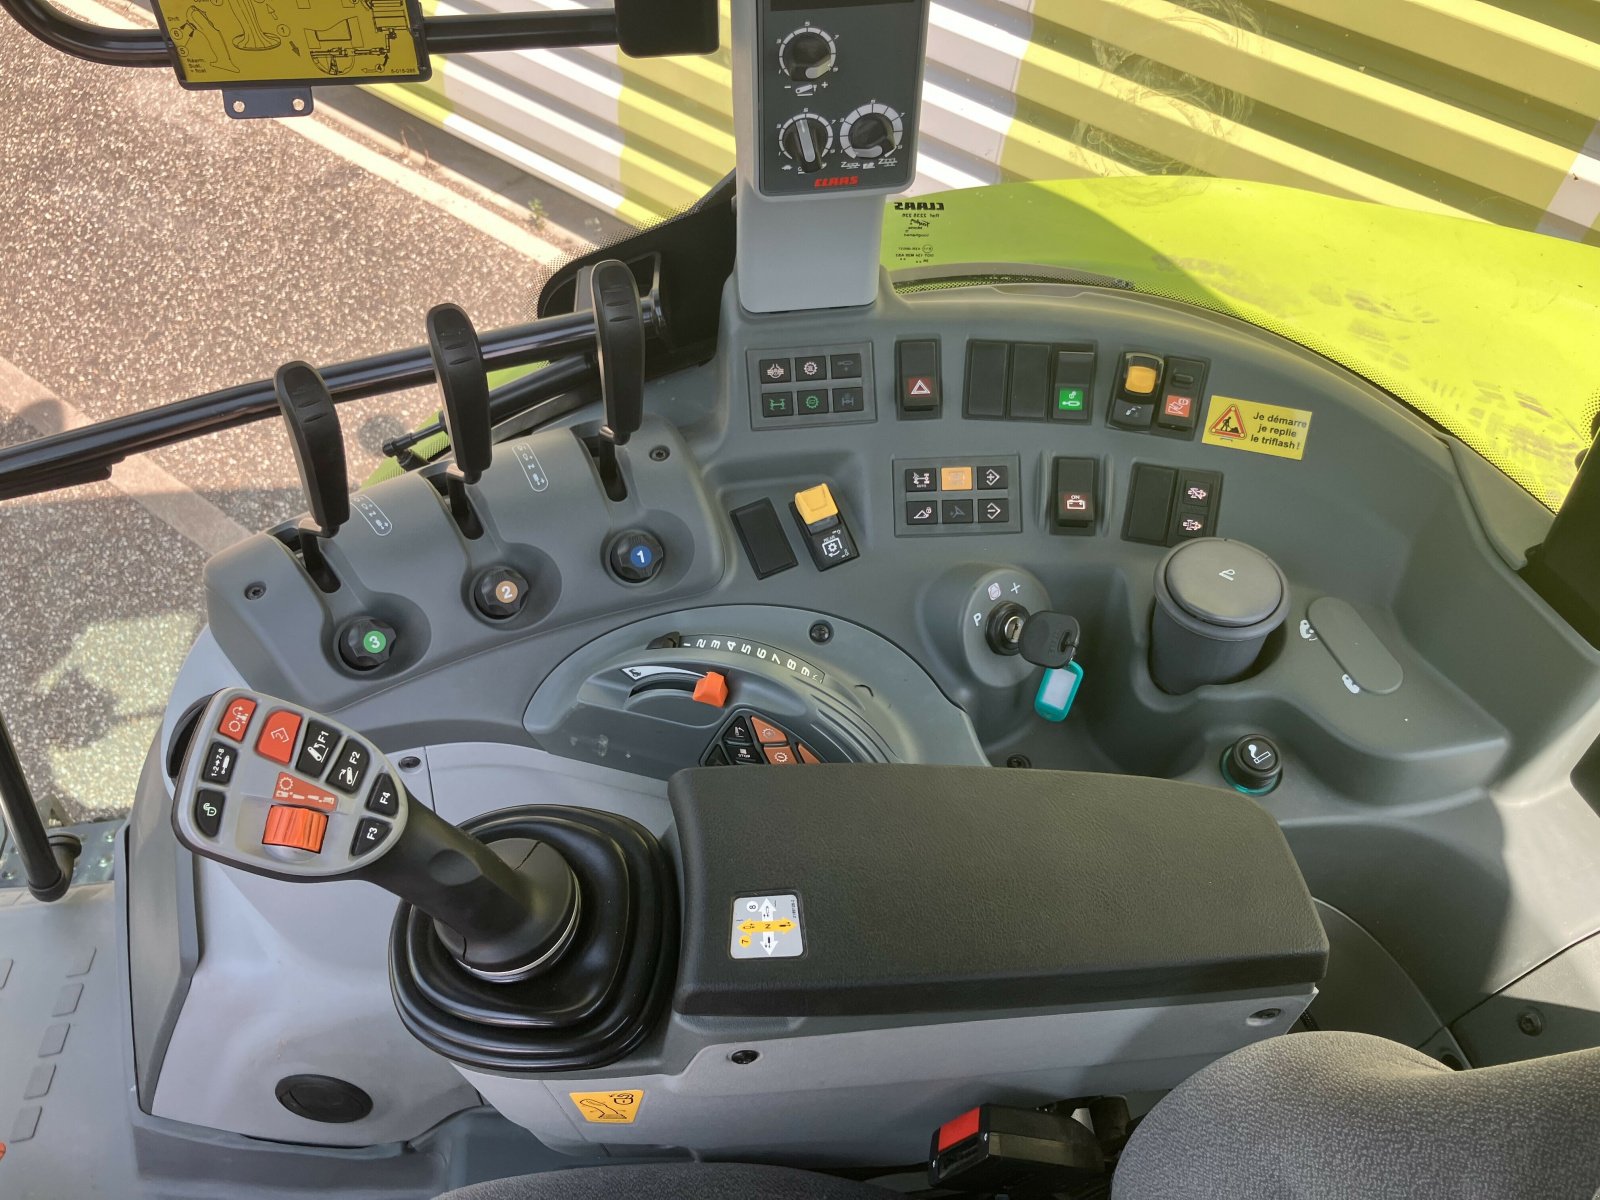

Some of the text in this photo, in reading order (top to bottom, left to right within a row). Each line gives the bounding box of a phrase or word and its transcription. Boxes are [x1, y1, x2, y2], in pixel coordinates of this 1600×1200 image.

[814, 176, 858, 188] CLAAS
[1253, 412, 1307, 428] Je démarre
[1257, 424, 1297, 438] je replie
[1262, 436, 1296, 449] triflash
[637, 550, 645, 563] 1
[501, 586, 512, 599] 2
[973, 613, 982, 626] P
[369, 636, 380, 648] 3
[696, 638, 706, 648] 2
[711, 640, 720, 649] 3
[726, 640, 736, 651] 4
[741, 644, 751, 655] 5
[757, 648, 767, 659] 6
[772, 654, 780, 665] 7
[786, 659, 796, 670] 8
[800, 666, 810, 677] 9
[318, 730, 329, 743] F1
[349, 751, 360, 764] F2
[380, 792, 390, 805] F4
[367, 827, 378, 840] F3
